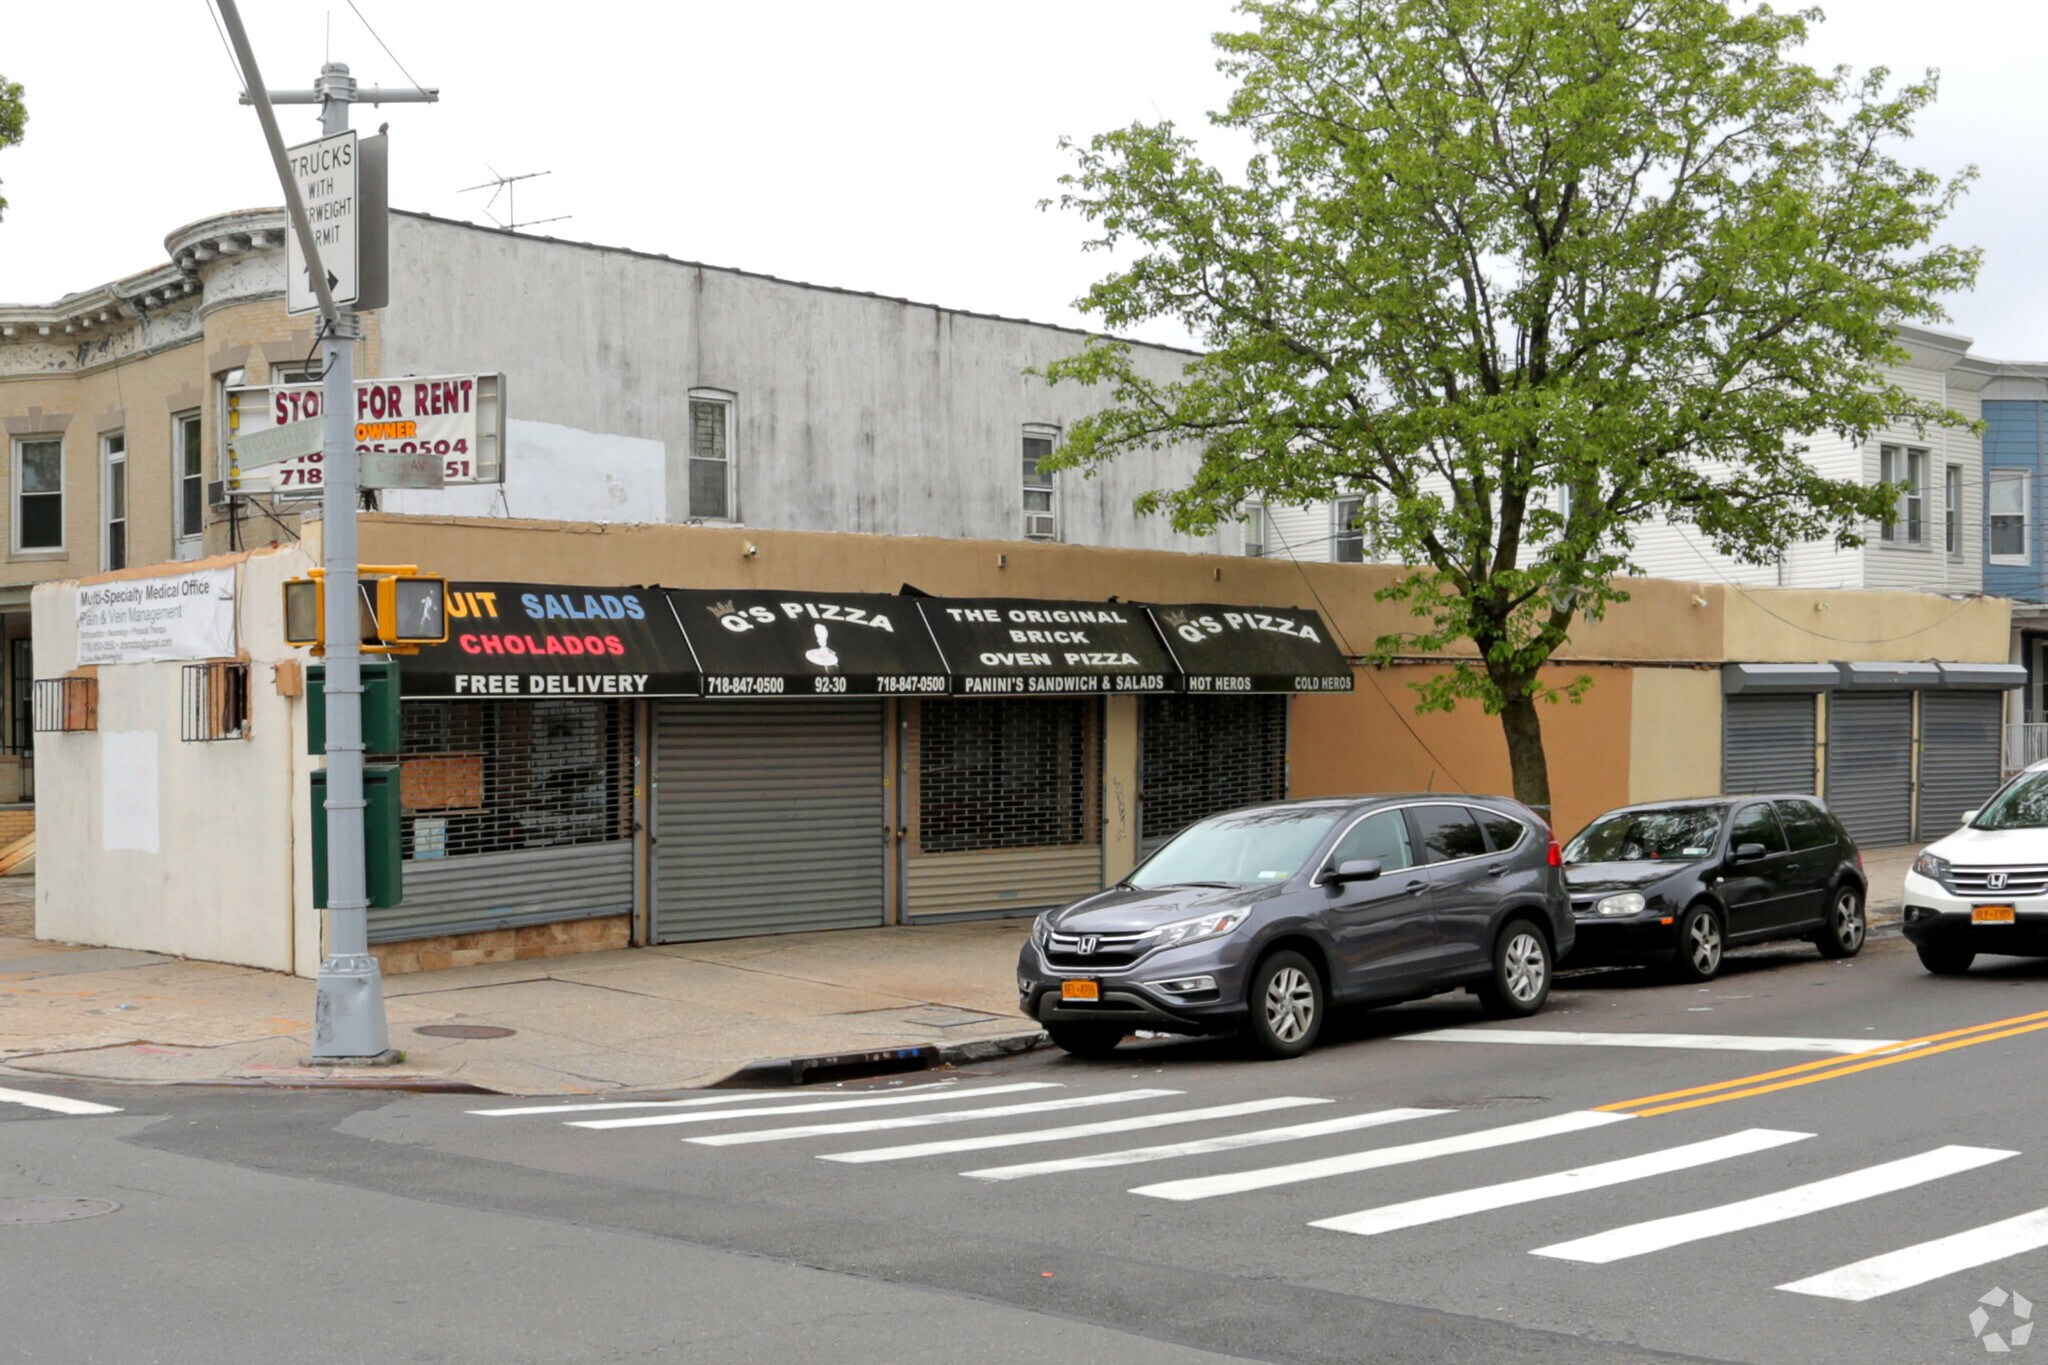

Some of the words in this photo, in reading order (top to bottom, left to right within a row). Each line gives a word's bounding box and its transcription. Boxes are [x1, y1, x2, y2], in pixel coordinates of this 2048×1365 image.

[291, 144, 352, 178] TRUCKS
[308, 177, 334, 200] WITH
[291, 197, 352, 229] RWEIGHT
[314, 225, 341, 247] RMIT
[276, 391, 324, 425] STO
[357, 385, 402, 420] FOR
[414, 380, 473, 416] RENT
[355, 420, 418, 442] OWNER
[80, 584, 144, 607] Multi-Specialty
[145, 581, 180, 600] Medical
[181, 578, 210, 596] Office
[80, 609, 99, 627] Pain
[100, 608, 107, 624] &
[108, 607, 127, 624] Vein
[128, 604, 183, 624] Management
[447, 592, 498, 618] UIT
[520, 593, 645, 620] SALADS
[946, 608, 1001, 623] THE
[1008, 609, 1128, 624] ORIGINAL
[720, 606, 776, 632] Q'S
[780, 602, 894, 633] PIZZA
[1177, 615, 1223, 643] Q'S
[1222, 612, 1321, 643] PIZZA
[459, 633, 625, 655] CHOLADOS
[1009, 629, 1090, 644] BRICK
[979, 652, 1052, 666] OVEN
[1064, 652, 1139, 666] PIZZA
[455, 675, 519, 693] FREE
[529, 674, 649, 693] DELIVERY
[708, 676, 784, 694] 718-847-0500
[815, 676, 847, 693] 92-30
[877, 675, 945, 692] 718-847-0500
[965, 677, 1024, 693] PANINI'S
[1028, 675, 1098, 692] SANDWICH
[1102, 675, 1111, 690] &
[1116, 675, 1164, 690] SALADS
[1189, 676, 1212, 691] HOT
[1215, 676, 1252, 691] HEROS
[1294, 676, 1319, 691] COLD
[1322, 675, 1352, 690] HEROS
